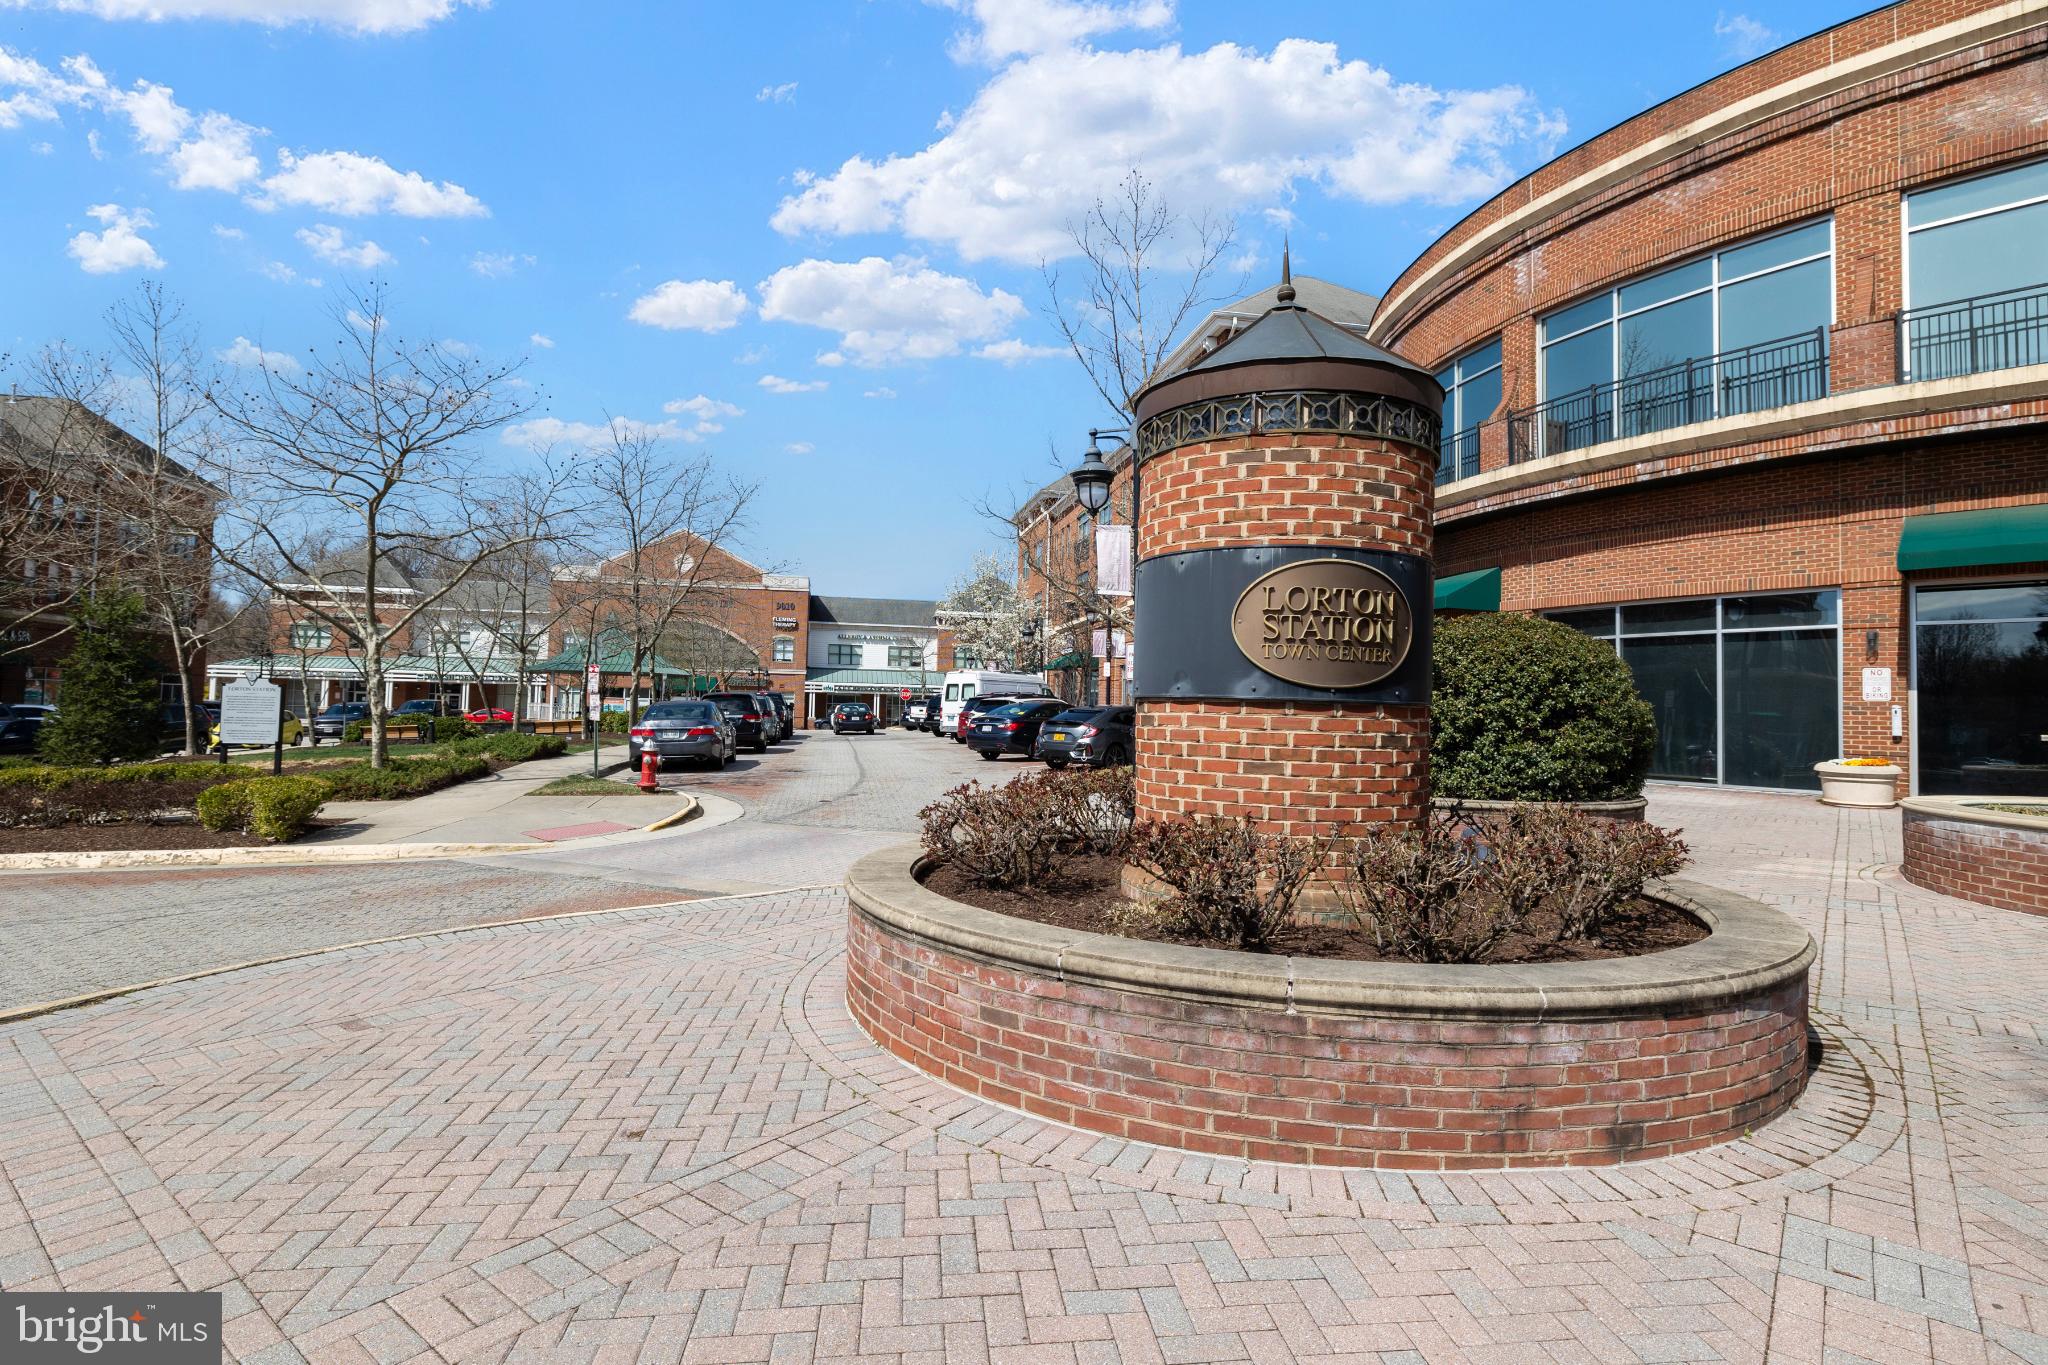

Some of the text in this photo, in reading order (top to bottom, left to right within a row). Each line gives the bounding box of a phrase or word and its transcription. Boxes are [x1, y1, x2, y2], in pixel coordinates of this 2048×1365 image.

[1262, 586, 1396, 616] LORTON
[1263, 614, 1396, 644] STATION
[1262, 643, 1393, 663] TOWN CENTER
